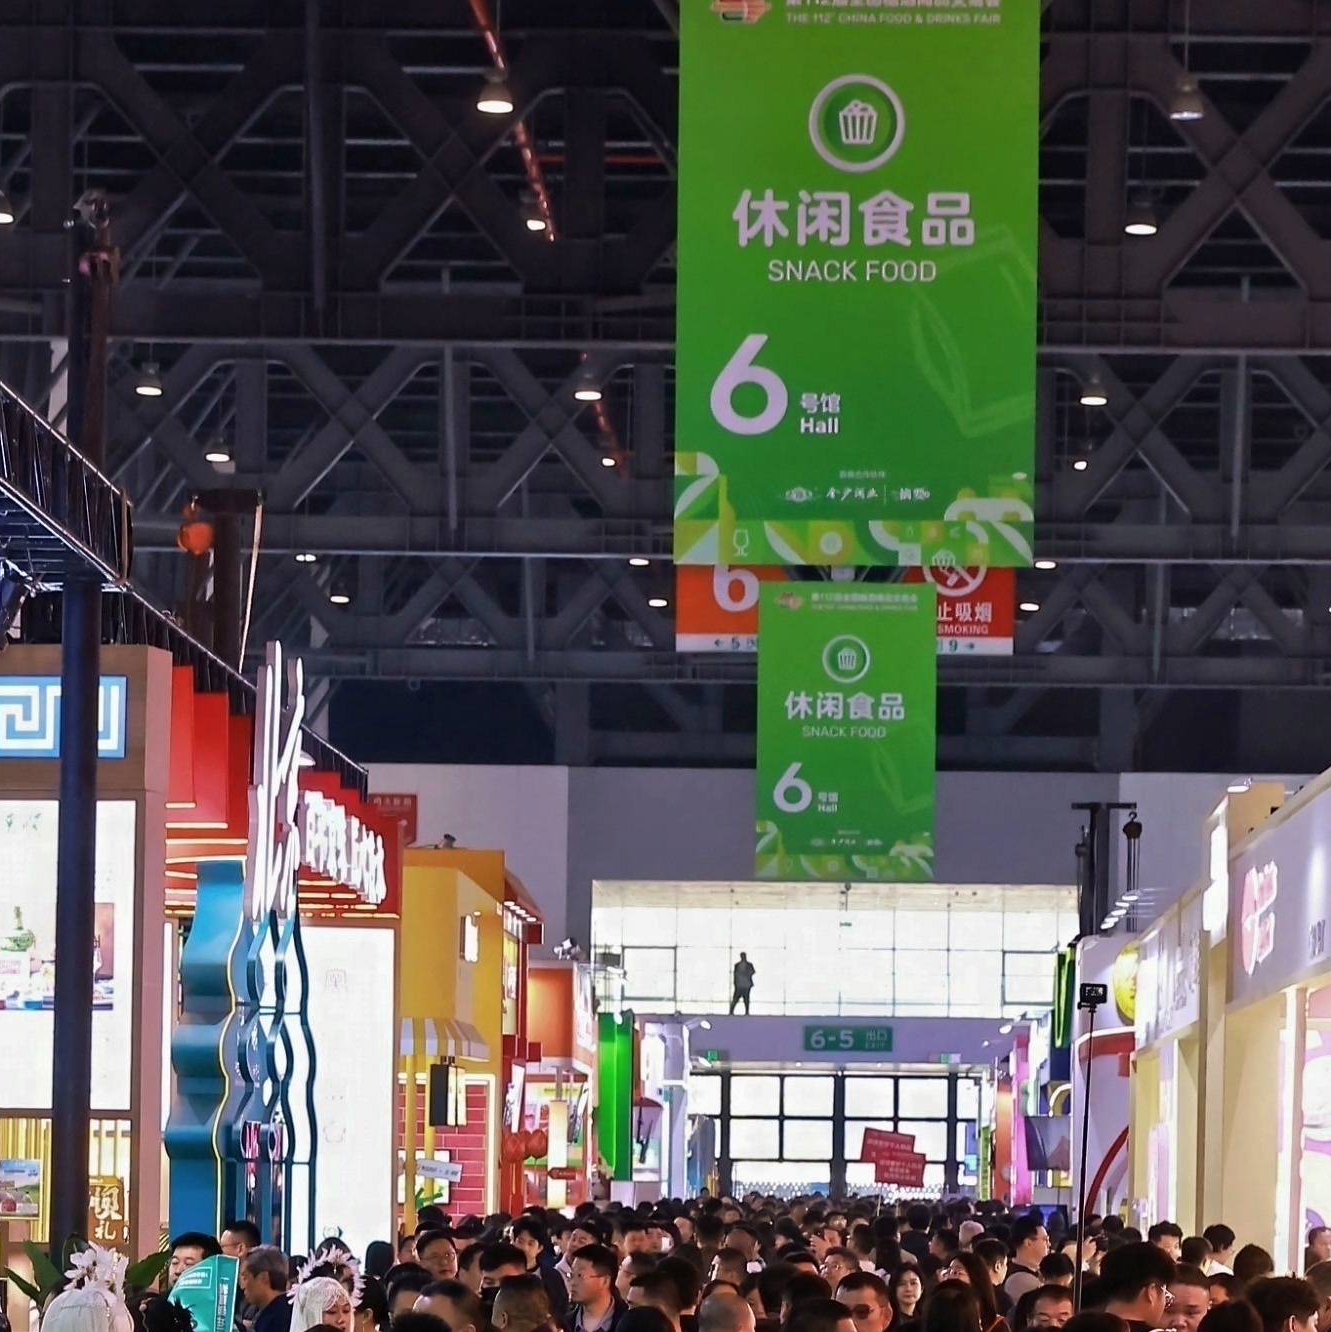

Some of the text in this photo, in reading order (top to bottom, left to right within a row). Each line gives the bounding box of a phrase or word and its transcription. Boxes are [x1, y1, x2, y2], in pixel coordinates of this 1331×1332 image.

[732, 189, 975, 247] 休闲食品
[768, 260, 937, 282] SNACK FOOD
[710, 333, 788, 435] 6
[800, 393, 841, 413] 号馆
[800, 417, 839, 434] Hall
[937, 624, 989, 636] SMOKING
[785, 691, 905, 721] 休闲食品
[802, 725, 887, 738] SNACK FOOD
[773, 762, 812, 813] 6
[810, 1030, 855, 1049] 6-5
